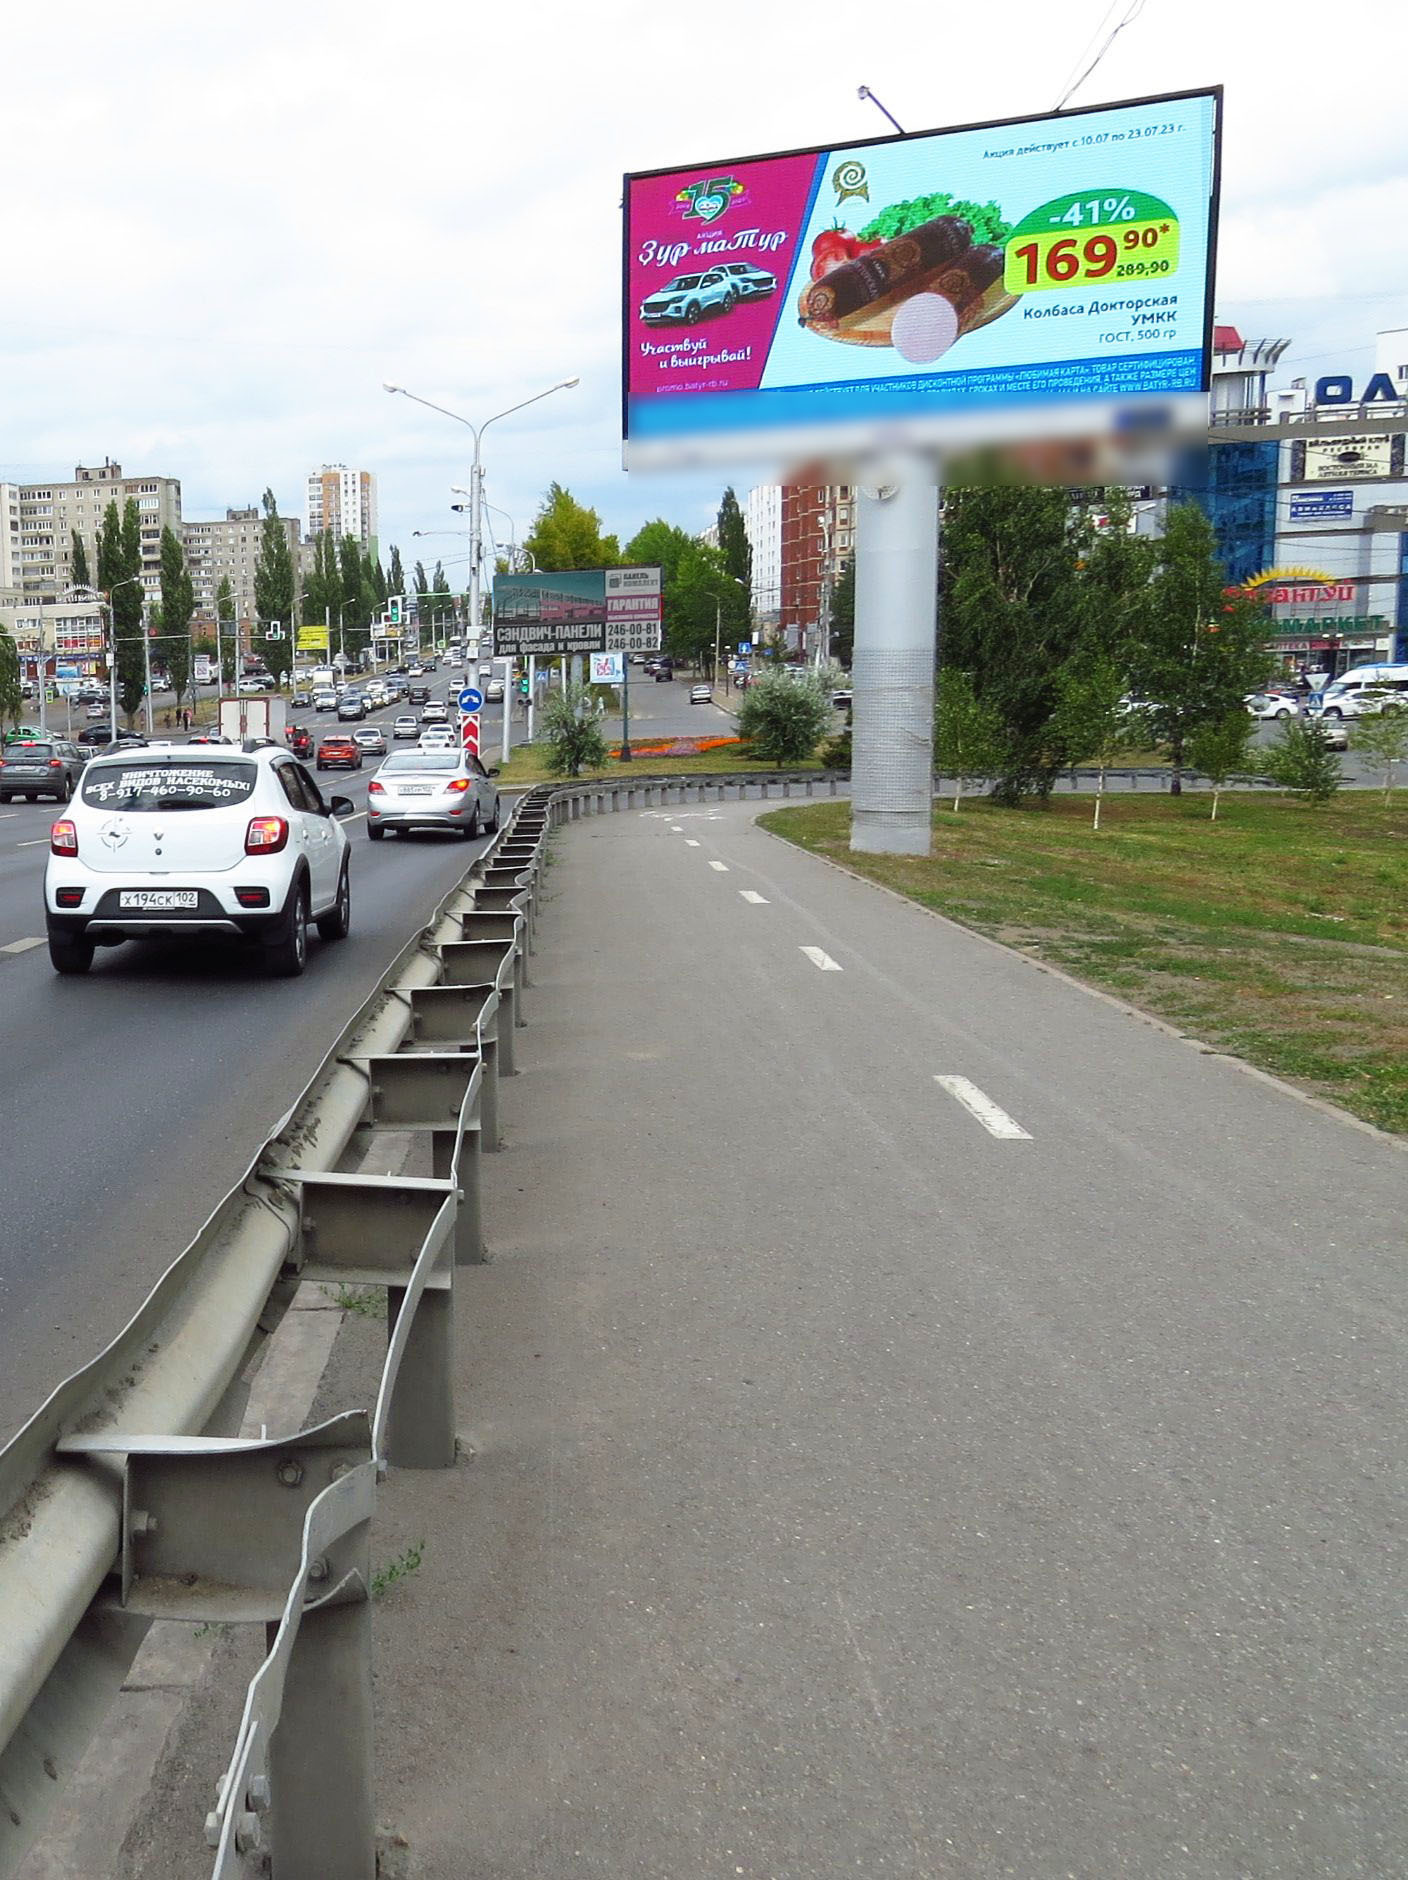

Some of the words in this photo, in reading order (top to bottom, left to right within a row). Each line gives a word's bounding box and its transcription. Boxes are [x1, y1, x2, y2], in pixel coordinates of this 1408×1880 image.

[983, 147, 1014, 159] Акция
[1016, 141, 1069, 156] действует
[1081, 133, 1109, 146] 10.07
[1112, 132, 1125, 143] по
[1128, 123, 1174, 139] 23.07.23
[1177, 124, 1187, 133] г.
[1049, 196, 1136, 227] -41%
[638, 239, 691, 267] Зур
[1015, 235, 1118, 285] 169
[1117, 259, 1170, 277] 289,90
[1024, 304, 1085, 320] Колбаса
[1088, 295, 1178, 315] Докторская
[1131, 310, 1178, 326] УМКК
[1099, 331, 1135, 343] ГОСТ,
[1137, 328, 1161, 341] 500
[1163, 329, 1177, 341] гр
[640, 338, 708, 356] Участвуй
[659, 360, 668, 369] и
[670, 346, 751, 370] выигрывай!
[1092, 361, 1118, 374] ТОВАР
[607, 597, 659, 612] ГАРАНТИЯ
[496, 623, 603, 643] СЭНДВИЧ-ПАНЕЛИ
[607, 622, 658, 637] 246-00-81
[498, 644, 517, 655] для
[519, 642, 555, 655] фасада
[557, 642, 565, 652] и
[567, 640, 601, 652] кровли
[607, 637, 659, 651] 246-00-82
[121, 769, 215, 781] УНИЧТОЖЕНИЕ
[85, 781, 116, 795] ВСЕХ
[119, 777, 161, 788] ВИДОВ
[166, 776, 251, 792] НАСЕКОМЫХ!
[99, 785, 232, 801] 8-917-460-90-60
[176, 892, 195, 902] 102
